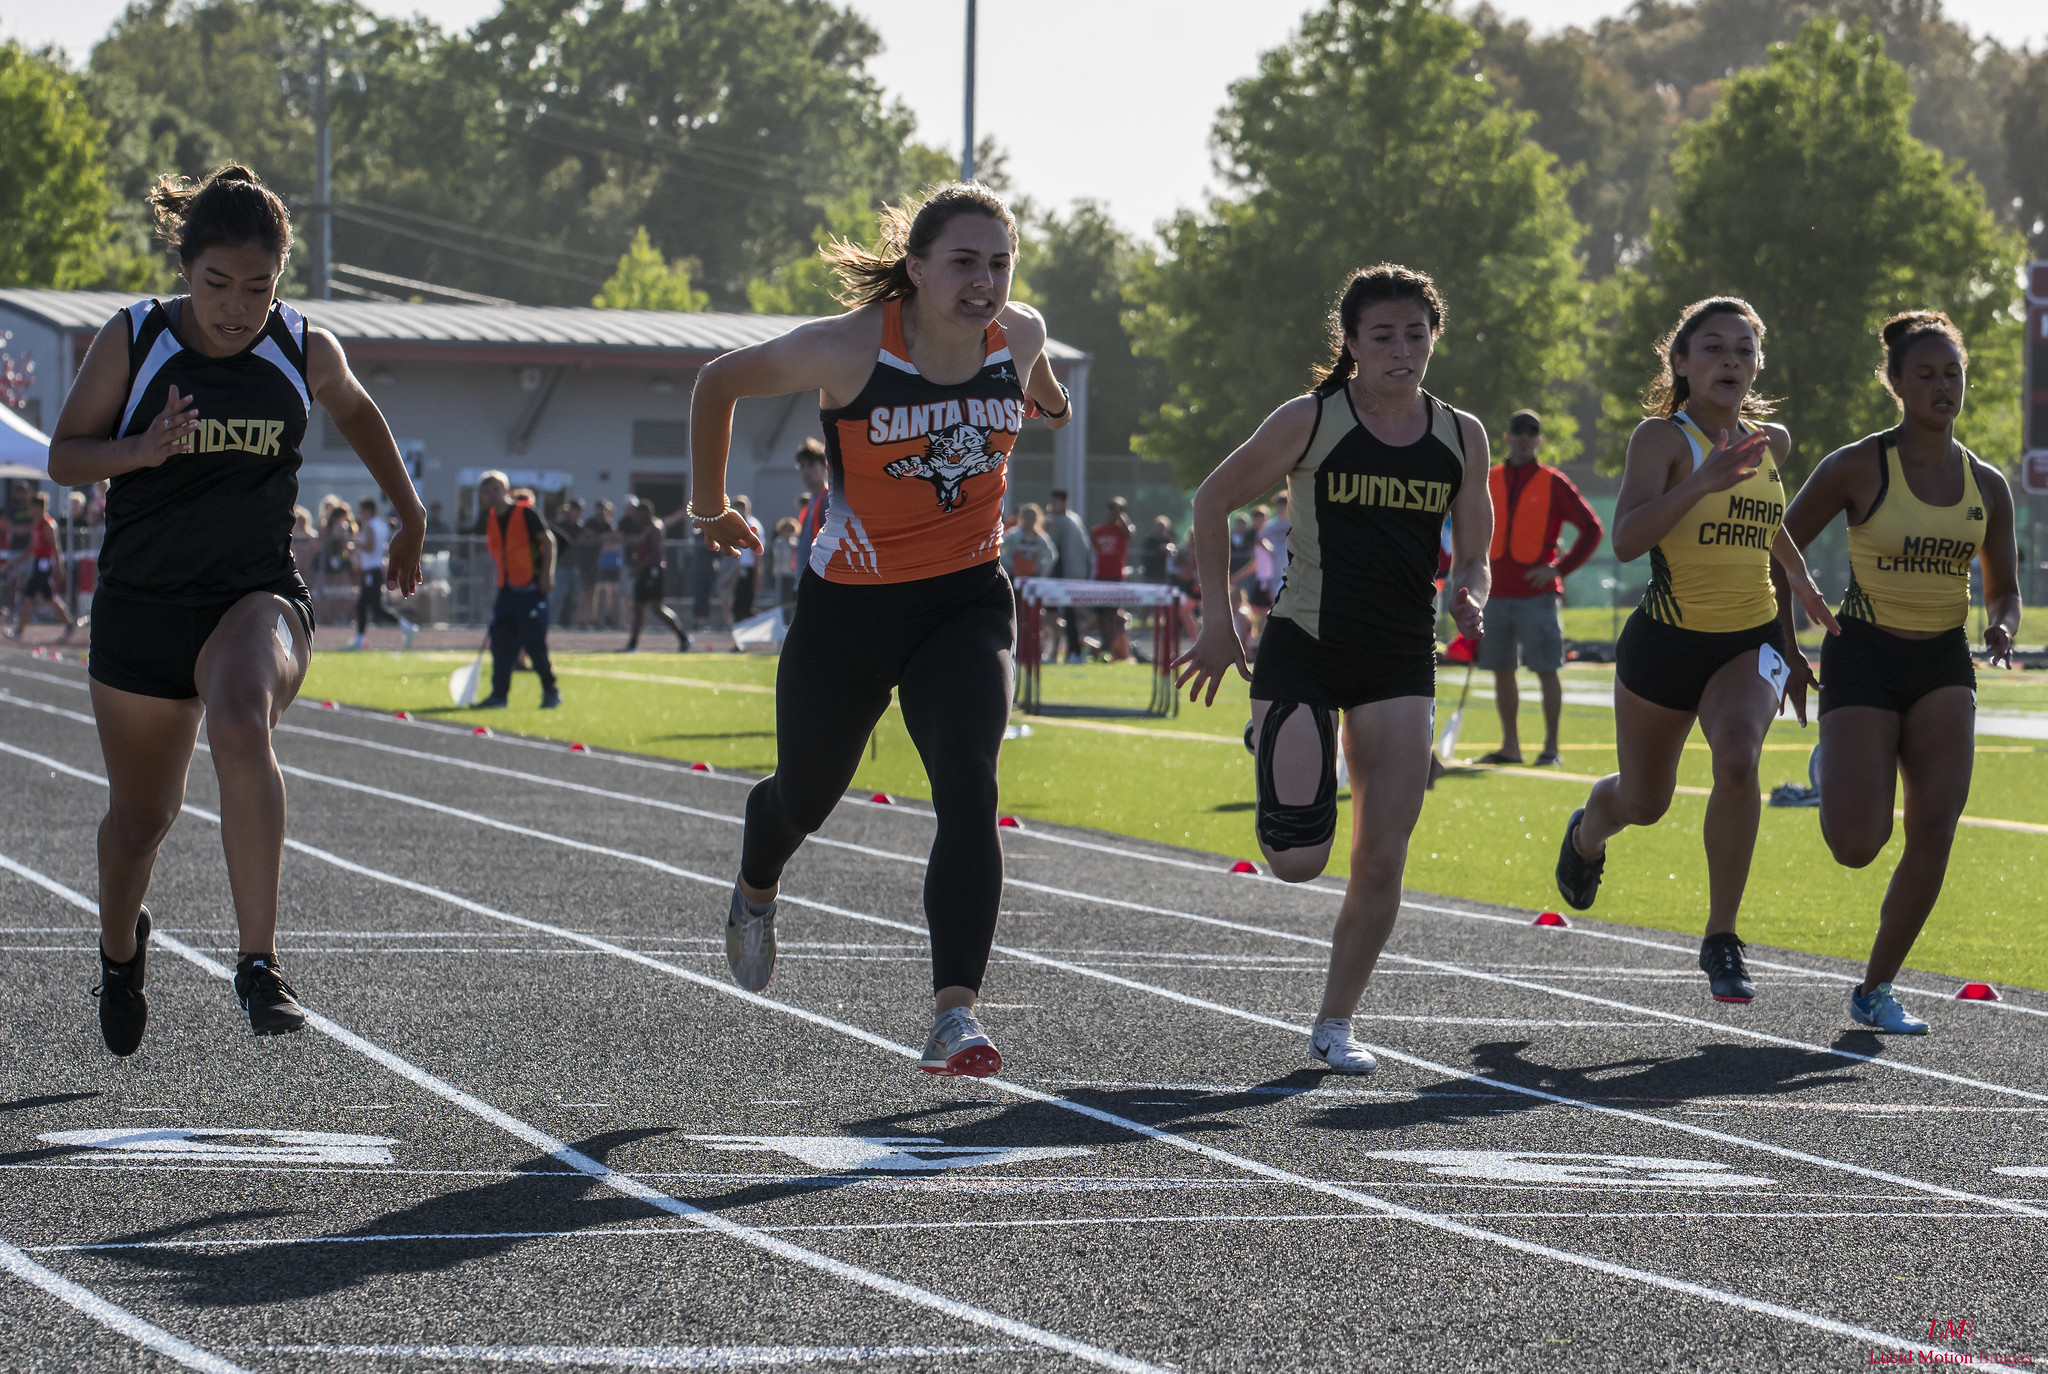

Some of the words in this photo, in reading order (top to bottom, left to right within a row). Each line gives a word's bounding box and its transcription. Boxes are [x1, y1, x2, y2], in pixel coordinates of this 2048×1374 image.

[870, 400, 962, 442] SANTA
[1327, 472, 1452, 513] WINDSOR
[1728, 495, 1783, 526] MARIA
[1698, 522, 1775, 551] CARRIL
[1903, 536, 1976, 560] MARIA
